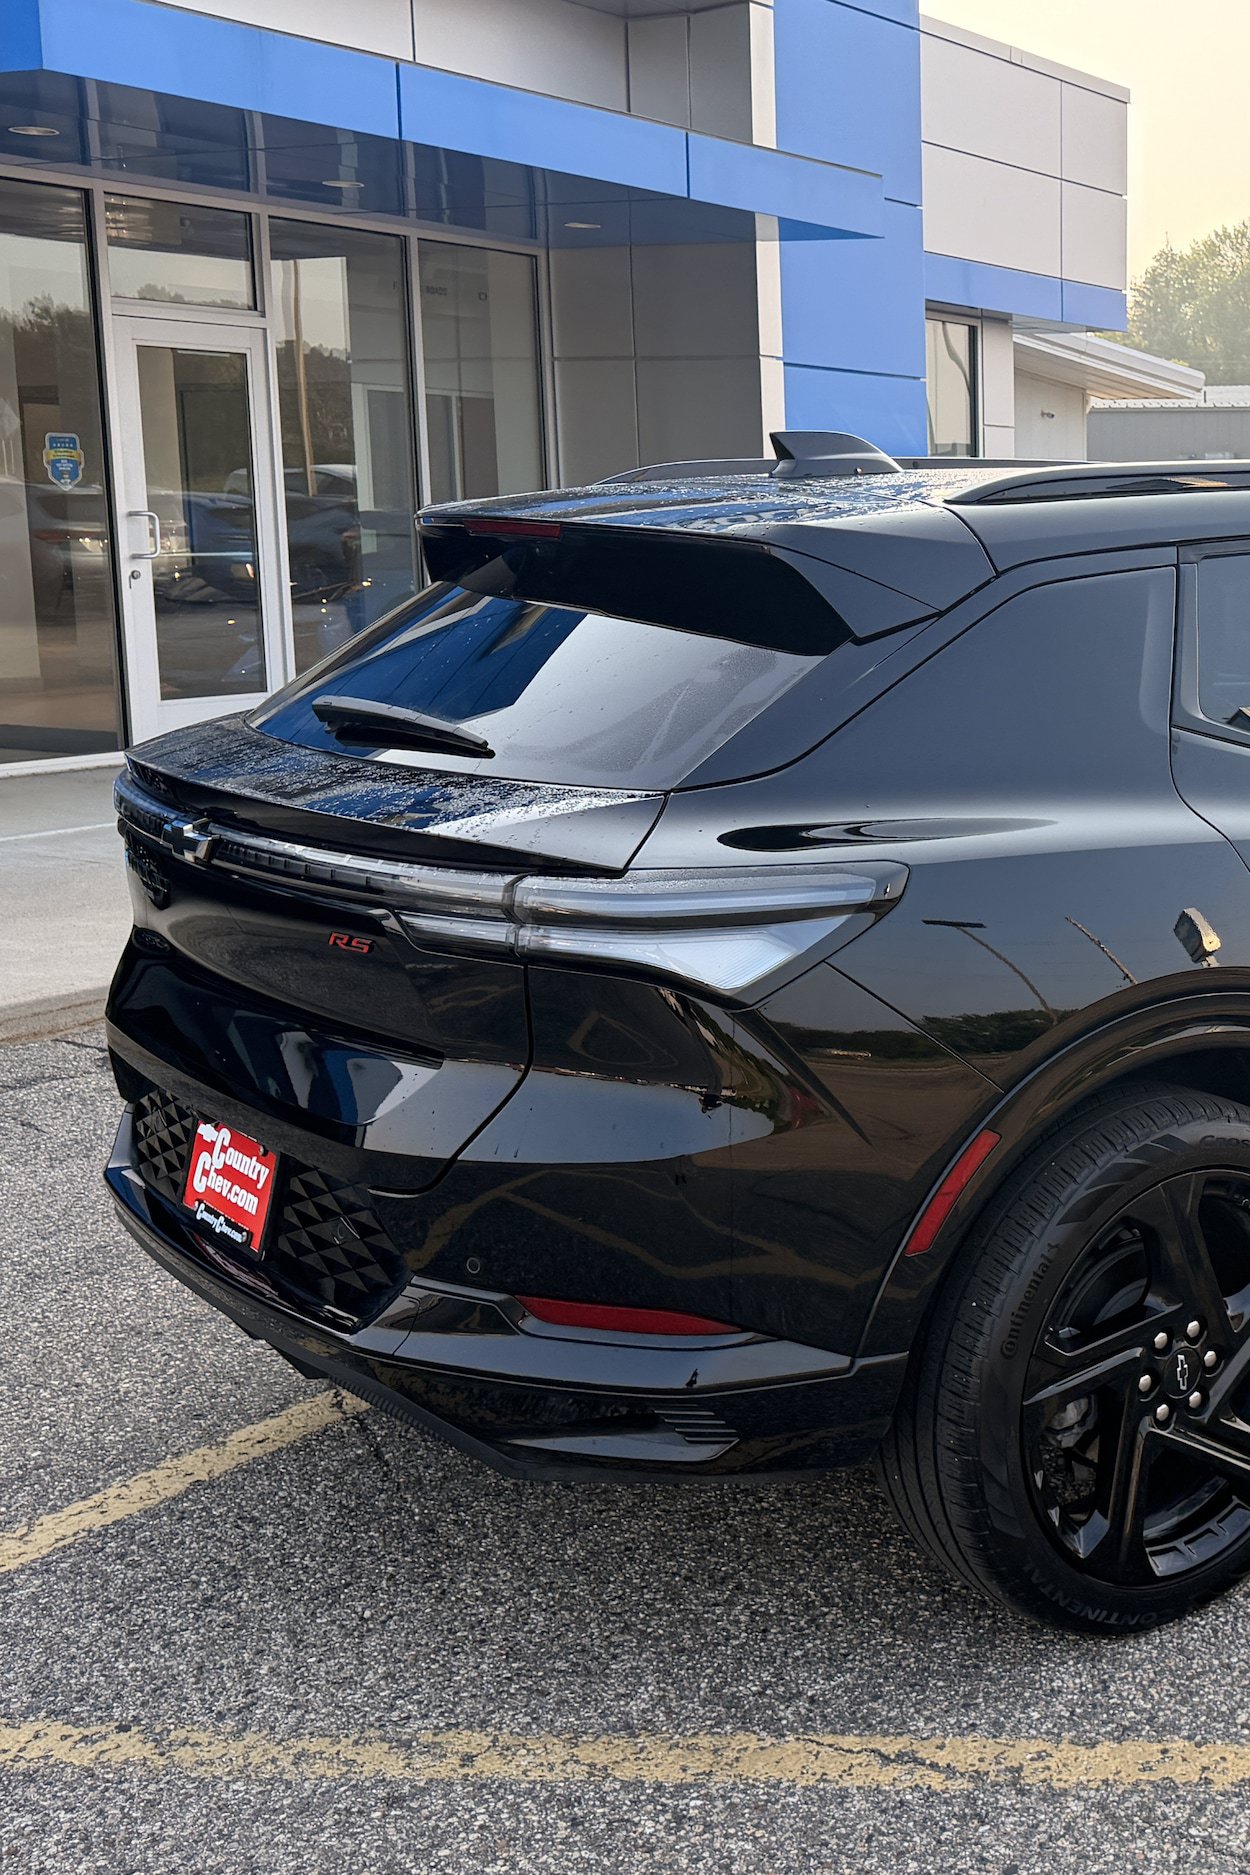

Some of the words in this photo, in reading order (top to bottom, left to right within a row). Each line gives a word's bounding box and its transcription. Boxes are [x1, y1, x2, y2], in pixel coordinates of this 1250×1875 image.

[329, 932, 371, 953] RS
[192, 1151, 259, 1216] Chev.com
[212, 1127, 270, 1190] Country
[1000, 1252, 1057, 1359] Continental
